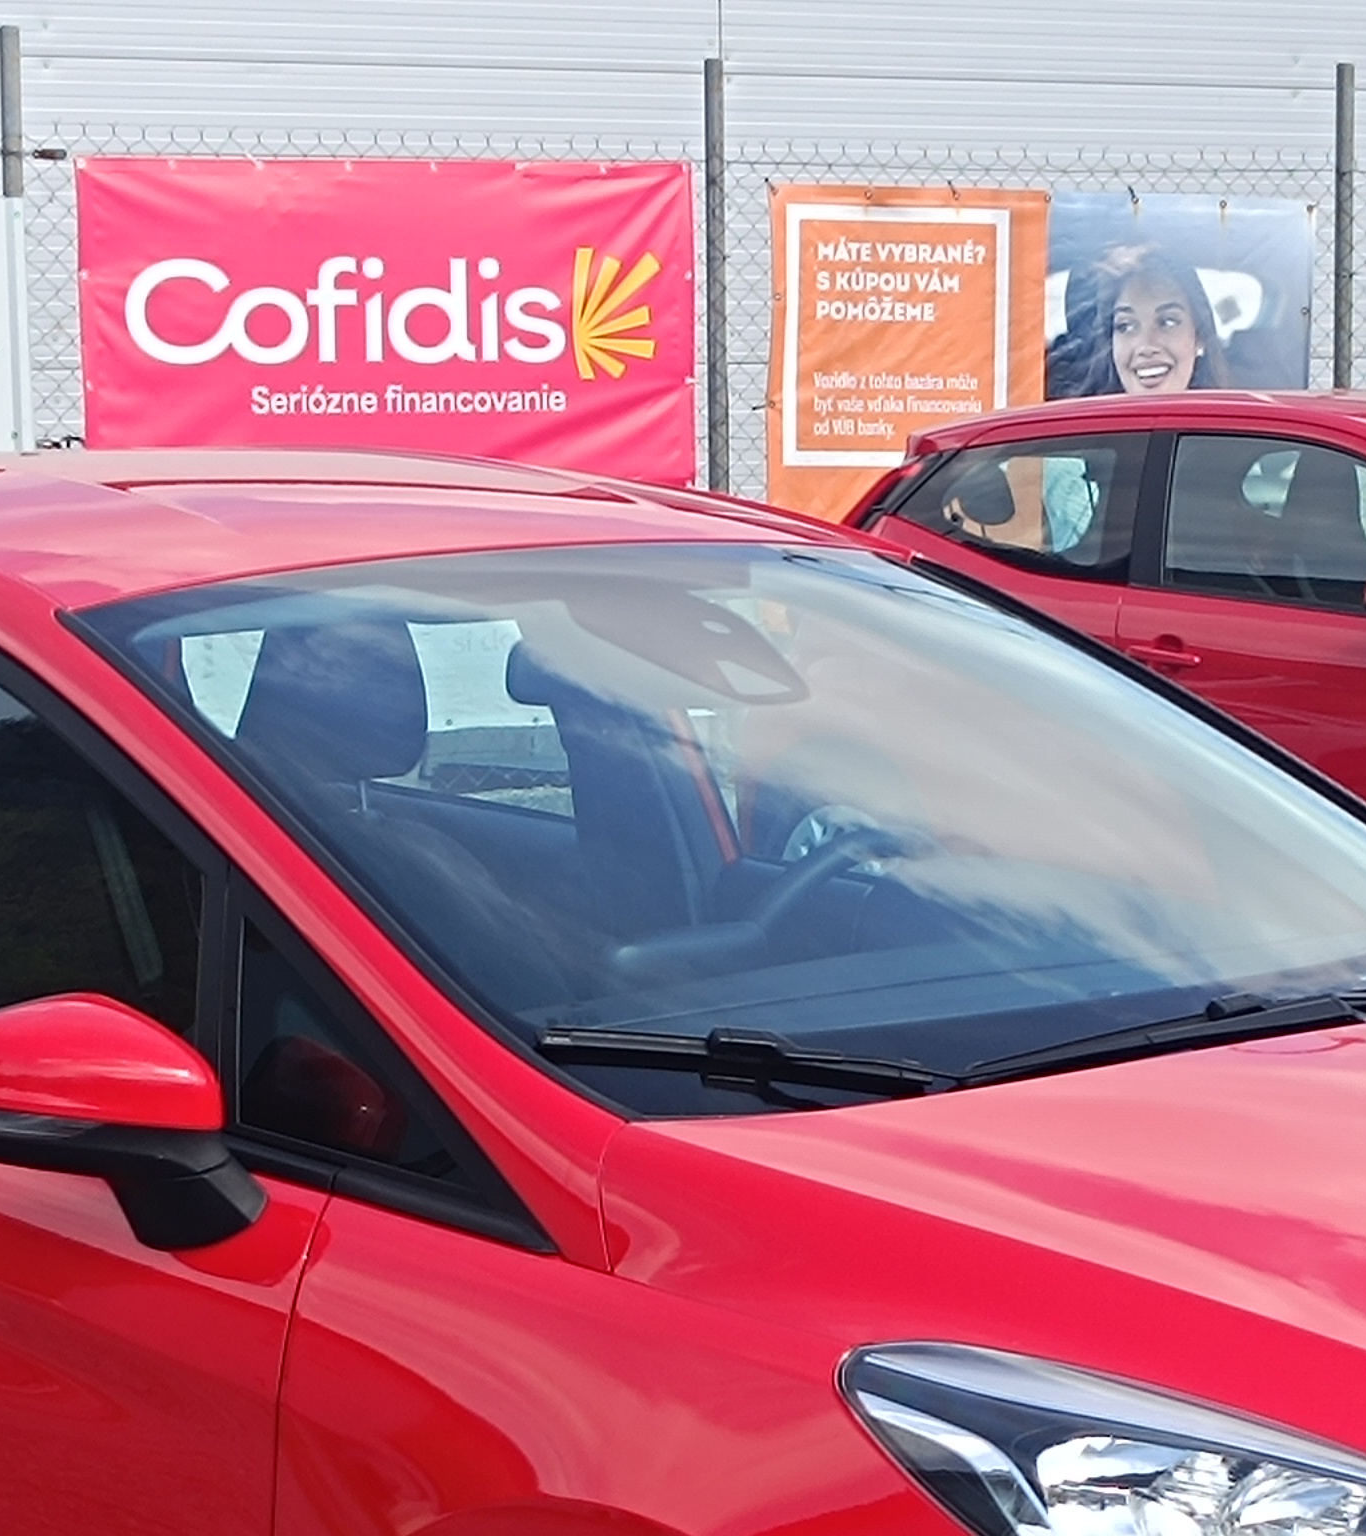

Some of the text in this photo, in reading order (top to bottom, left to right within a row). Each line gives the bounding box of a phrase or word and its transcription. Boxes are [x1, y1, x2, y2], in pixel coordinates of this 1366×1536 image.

[817, 236, 987, 265] MÁTE VYBRANÉ?
[815, 267, 961, 293] S KÚPOU VÁM
[123, 256, 567, 365] Cofidis
[815, 296, 936, 322] POMÔŽEME
[860, 376, 867, 389] z
[869, 372, 902, 390] tohto
[250, 383, 567, 414] Seriózne financovanie
[814, 418, 830, 436] od
